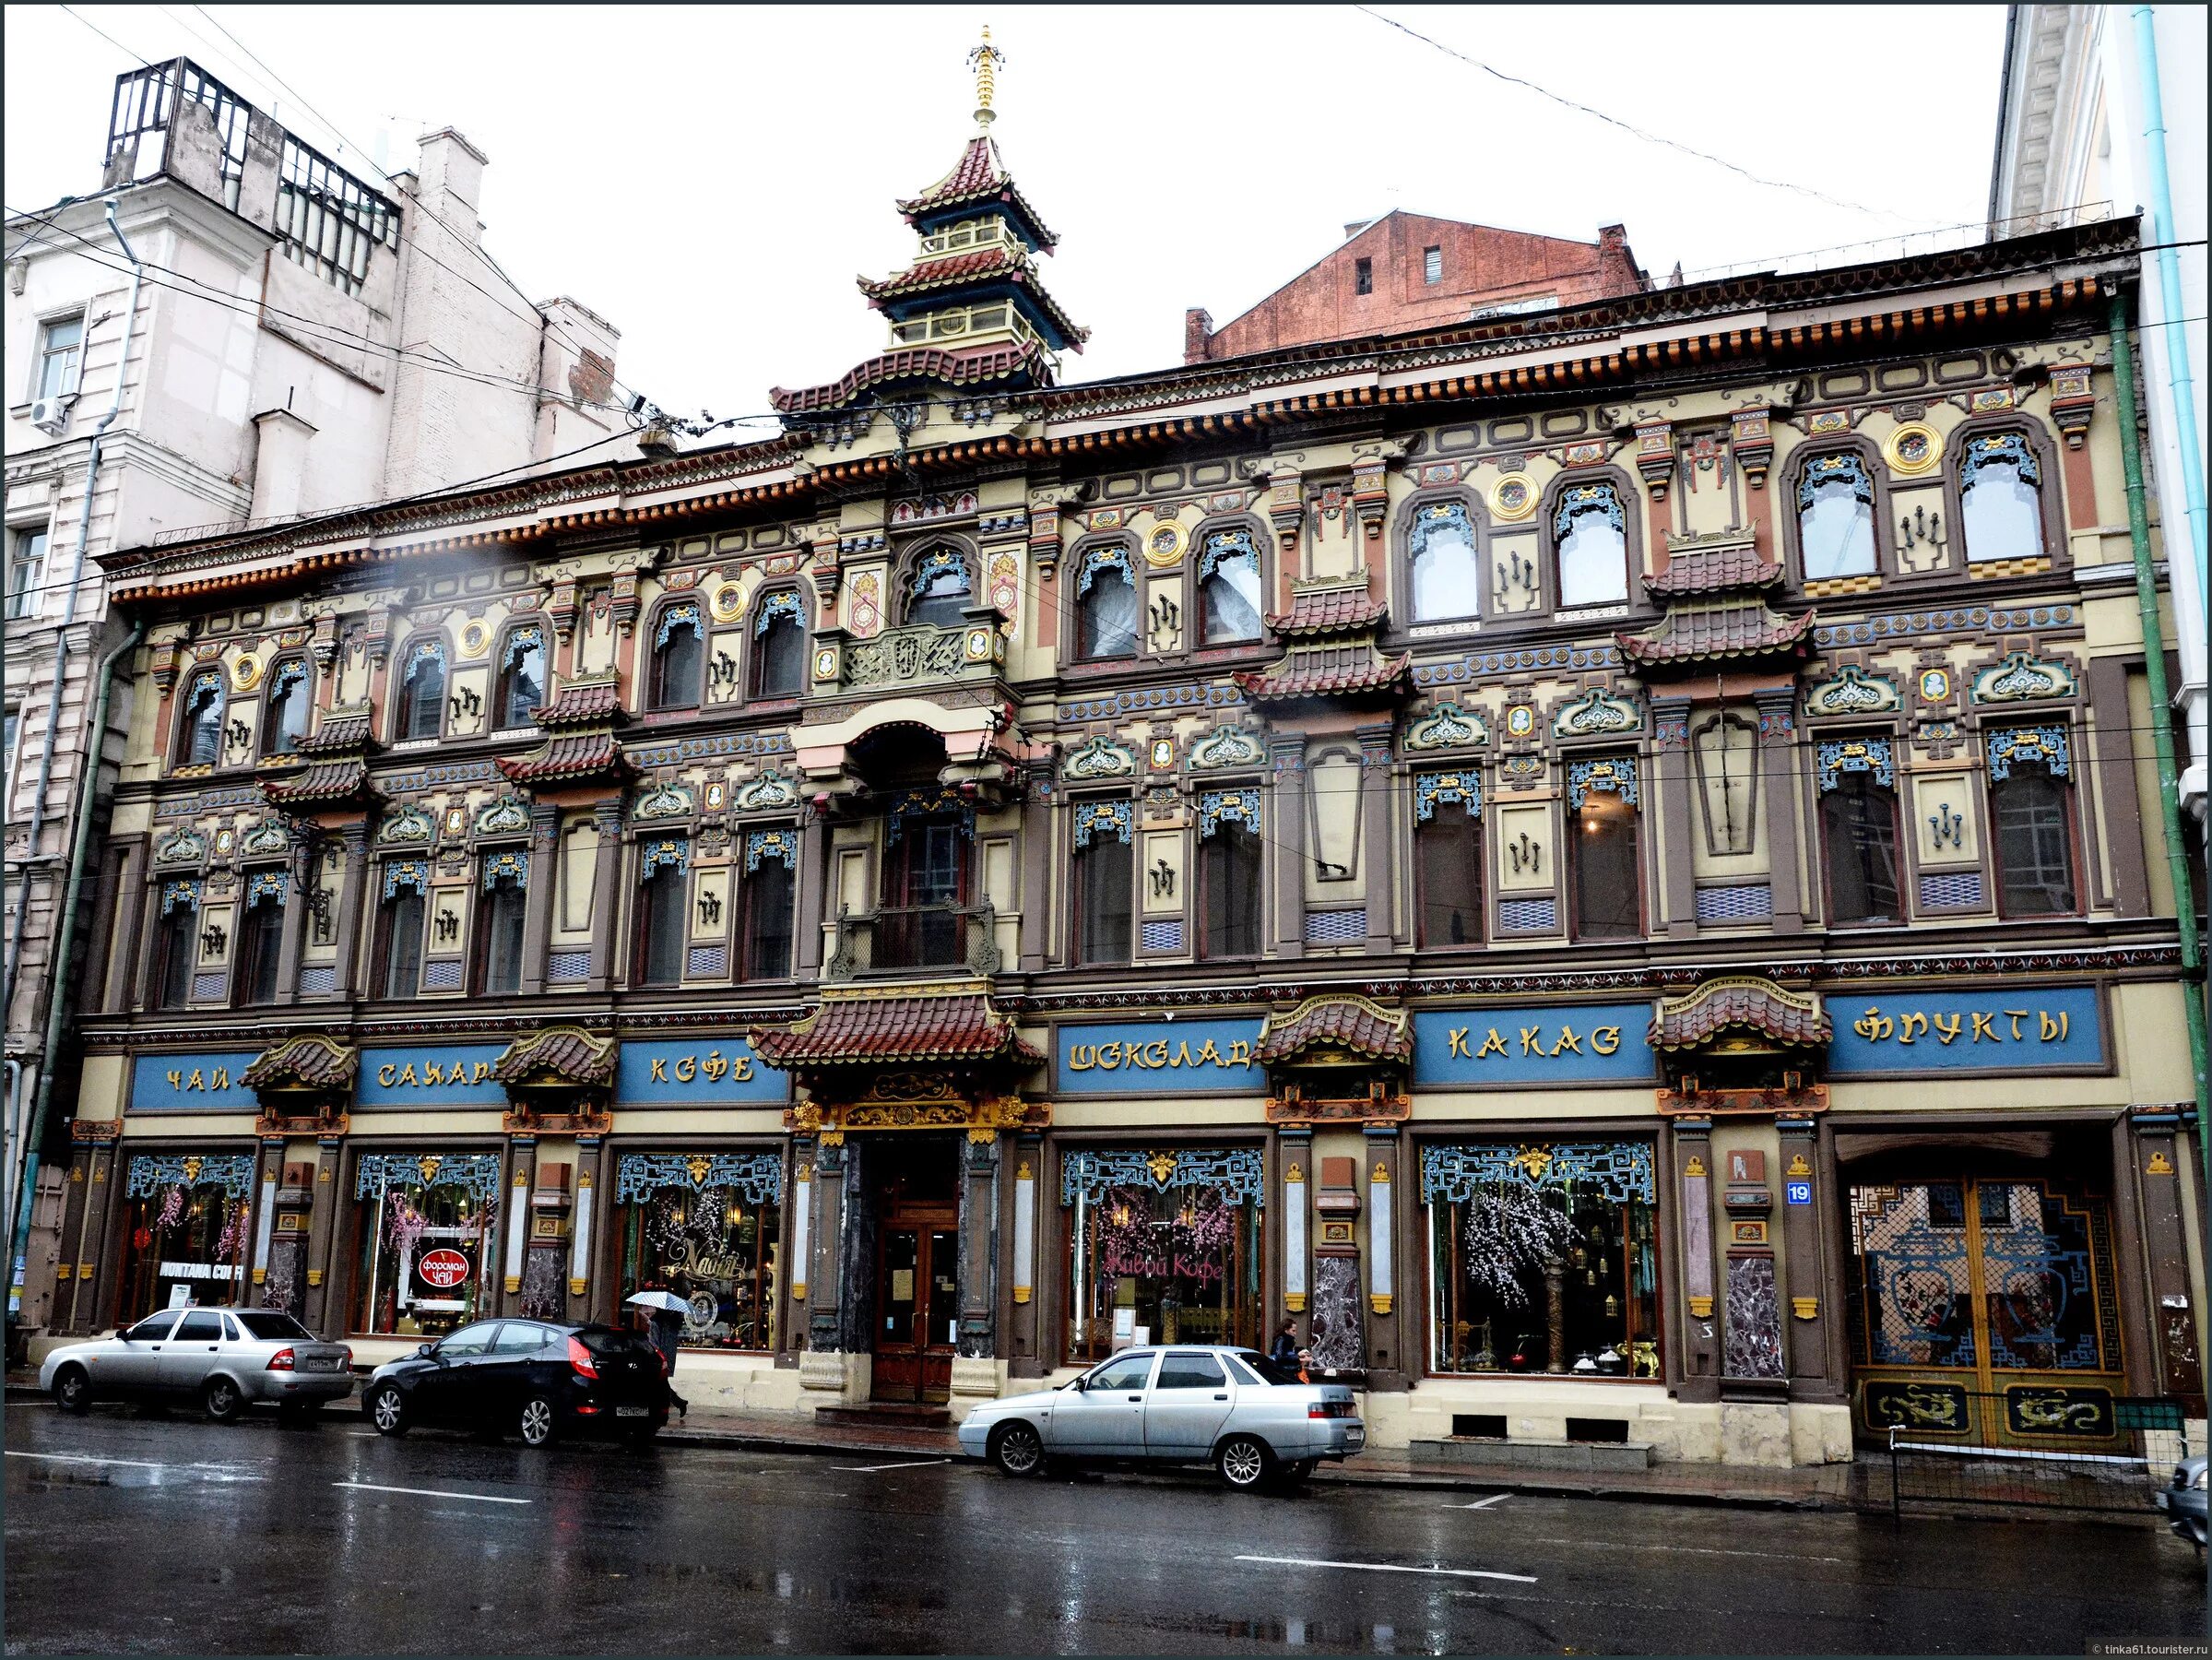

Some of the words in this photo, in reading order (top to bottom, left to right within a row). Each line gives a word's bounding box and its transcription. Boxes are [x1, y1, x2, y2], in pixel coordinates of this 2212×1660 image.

[1853, 1006, 2069, 1045] ФРУКТЫ
[1069, 1038, 1252, 1071] ШОКОЛАД
[1448, 1025, 1621, 1059] КАКАО
[166, 1066, 230, 1091] ЧАЙ
[378, 1060, 490, 1087] САХАР
[651, 1049, 754, 1083] КОФЕ
[1789, 1186, 1808, 1201] 19
[160, 1262, 212, 1279] MONTANA
[432, 1271, 453, 1285] ЧАЙ
[1103, 1252, 1167, 1276] Живой
[1173, 1251, 1224, 1290] Кофе
